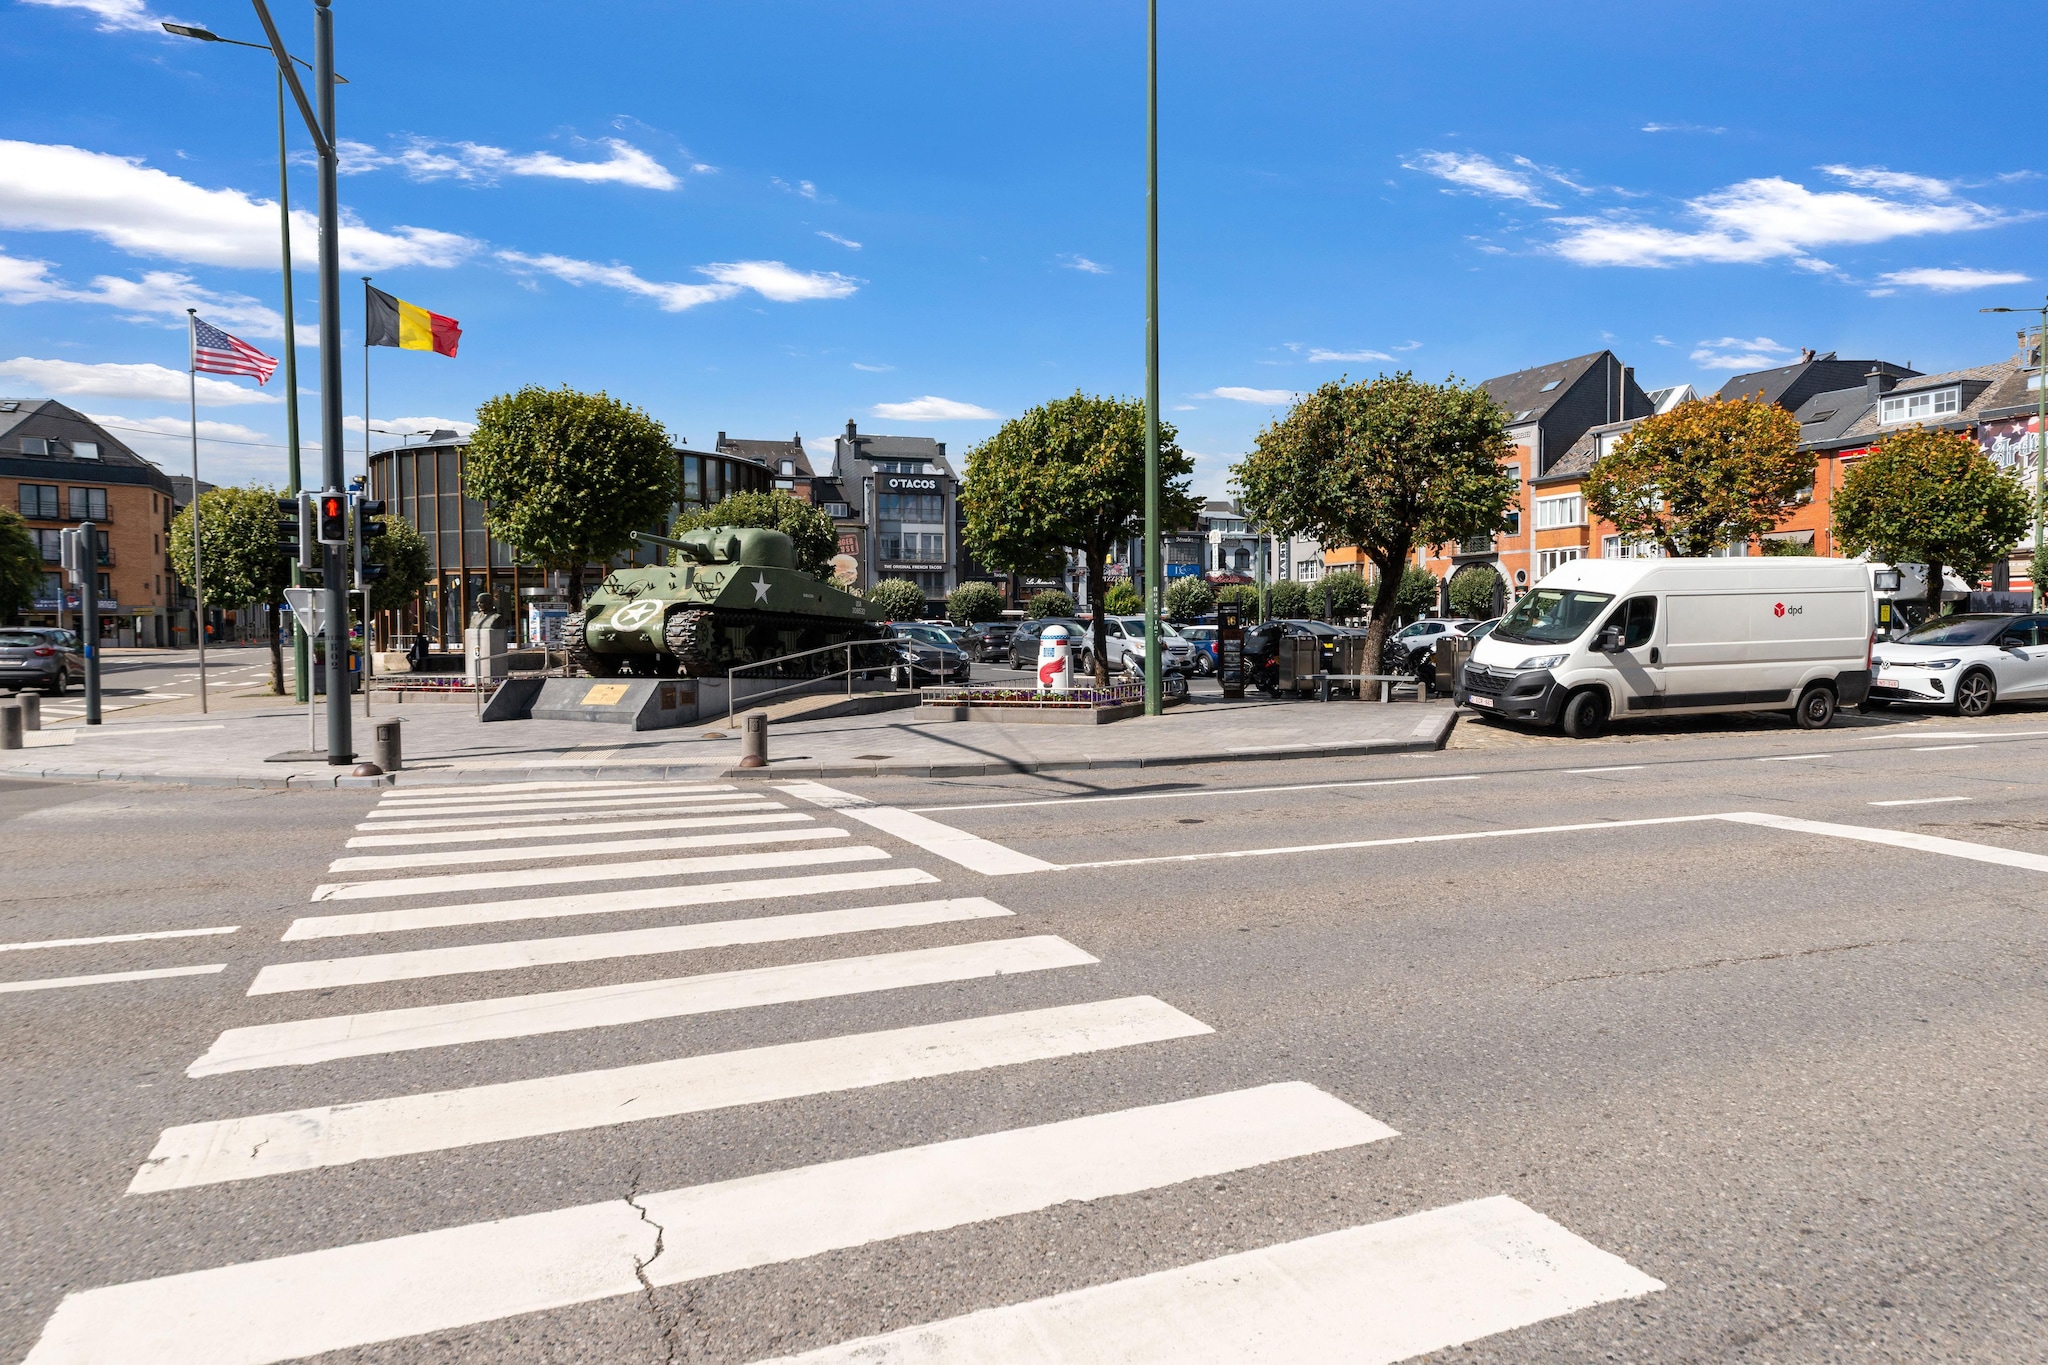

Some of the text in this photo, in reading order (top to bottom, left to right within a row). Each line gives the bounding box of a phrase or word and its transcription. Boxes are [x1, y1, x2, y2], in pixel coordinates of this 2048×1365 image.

[889, 478, 936, 489] O'TACOS
[1788, 605, 1802, 616] dpd
[1226, 616, 1236, 626] 16
